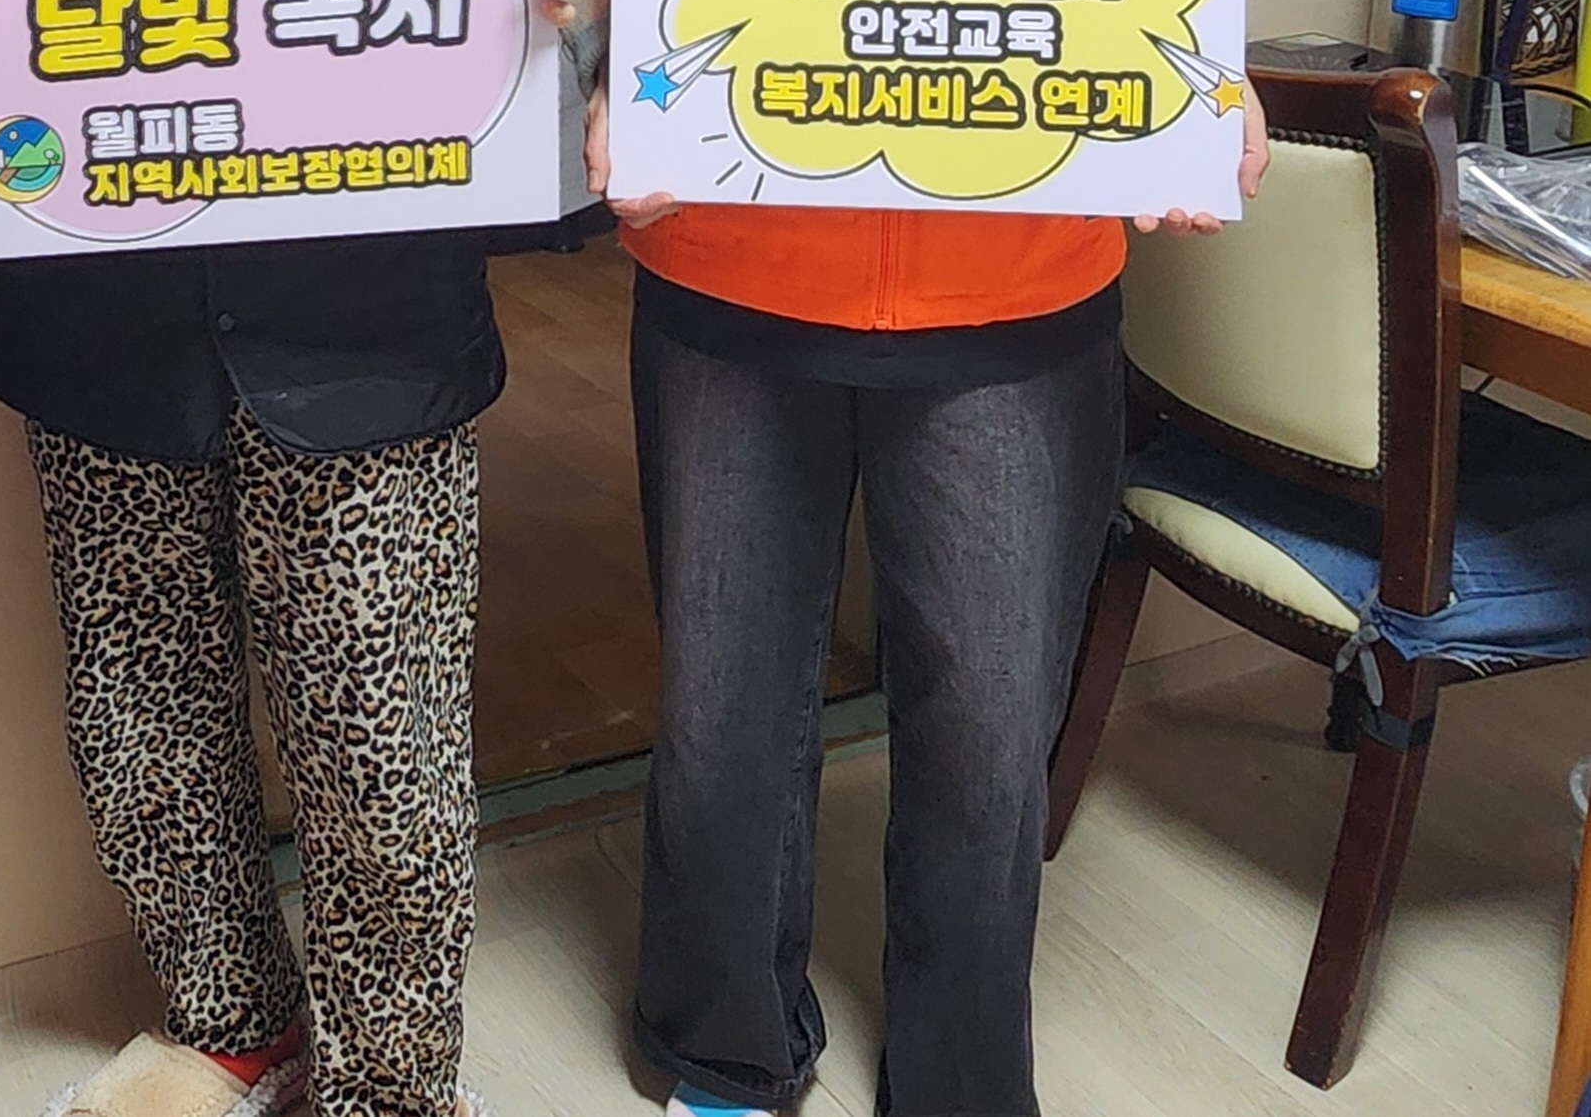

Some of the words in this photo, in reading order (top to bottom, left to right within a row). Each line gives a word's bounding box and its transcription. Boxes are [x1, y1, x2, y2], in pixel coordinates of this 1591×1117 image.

[842, 1, 1061, 64] 안전교육
[83, 99, 244, 159] 월피동
[755, 63, 1026, 129] 복지서비스
[1035, 70, 1151, 136] 연계
[83, 137, 473, 208] 지역사회보장협의체
